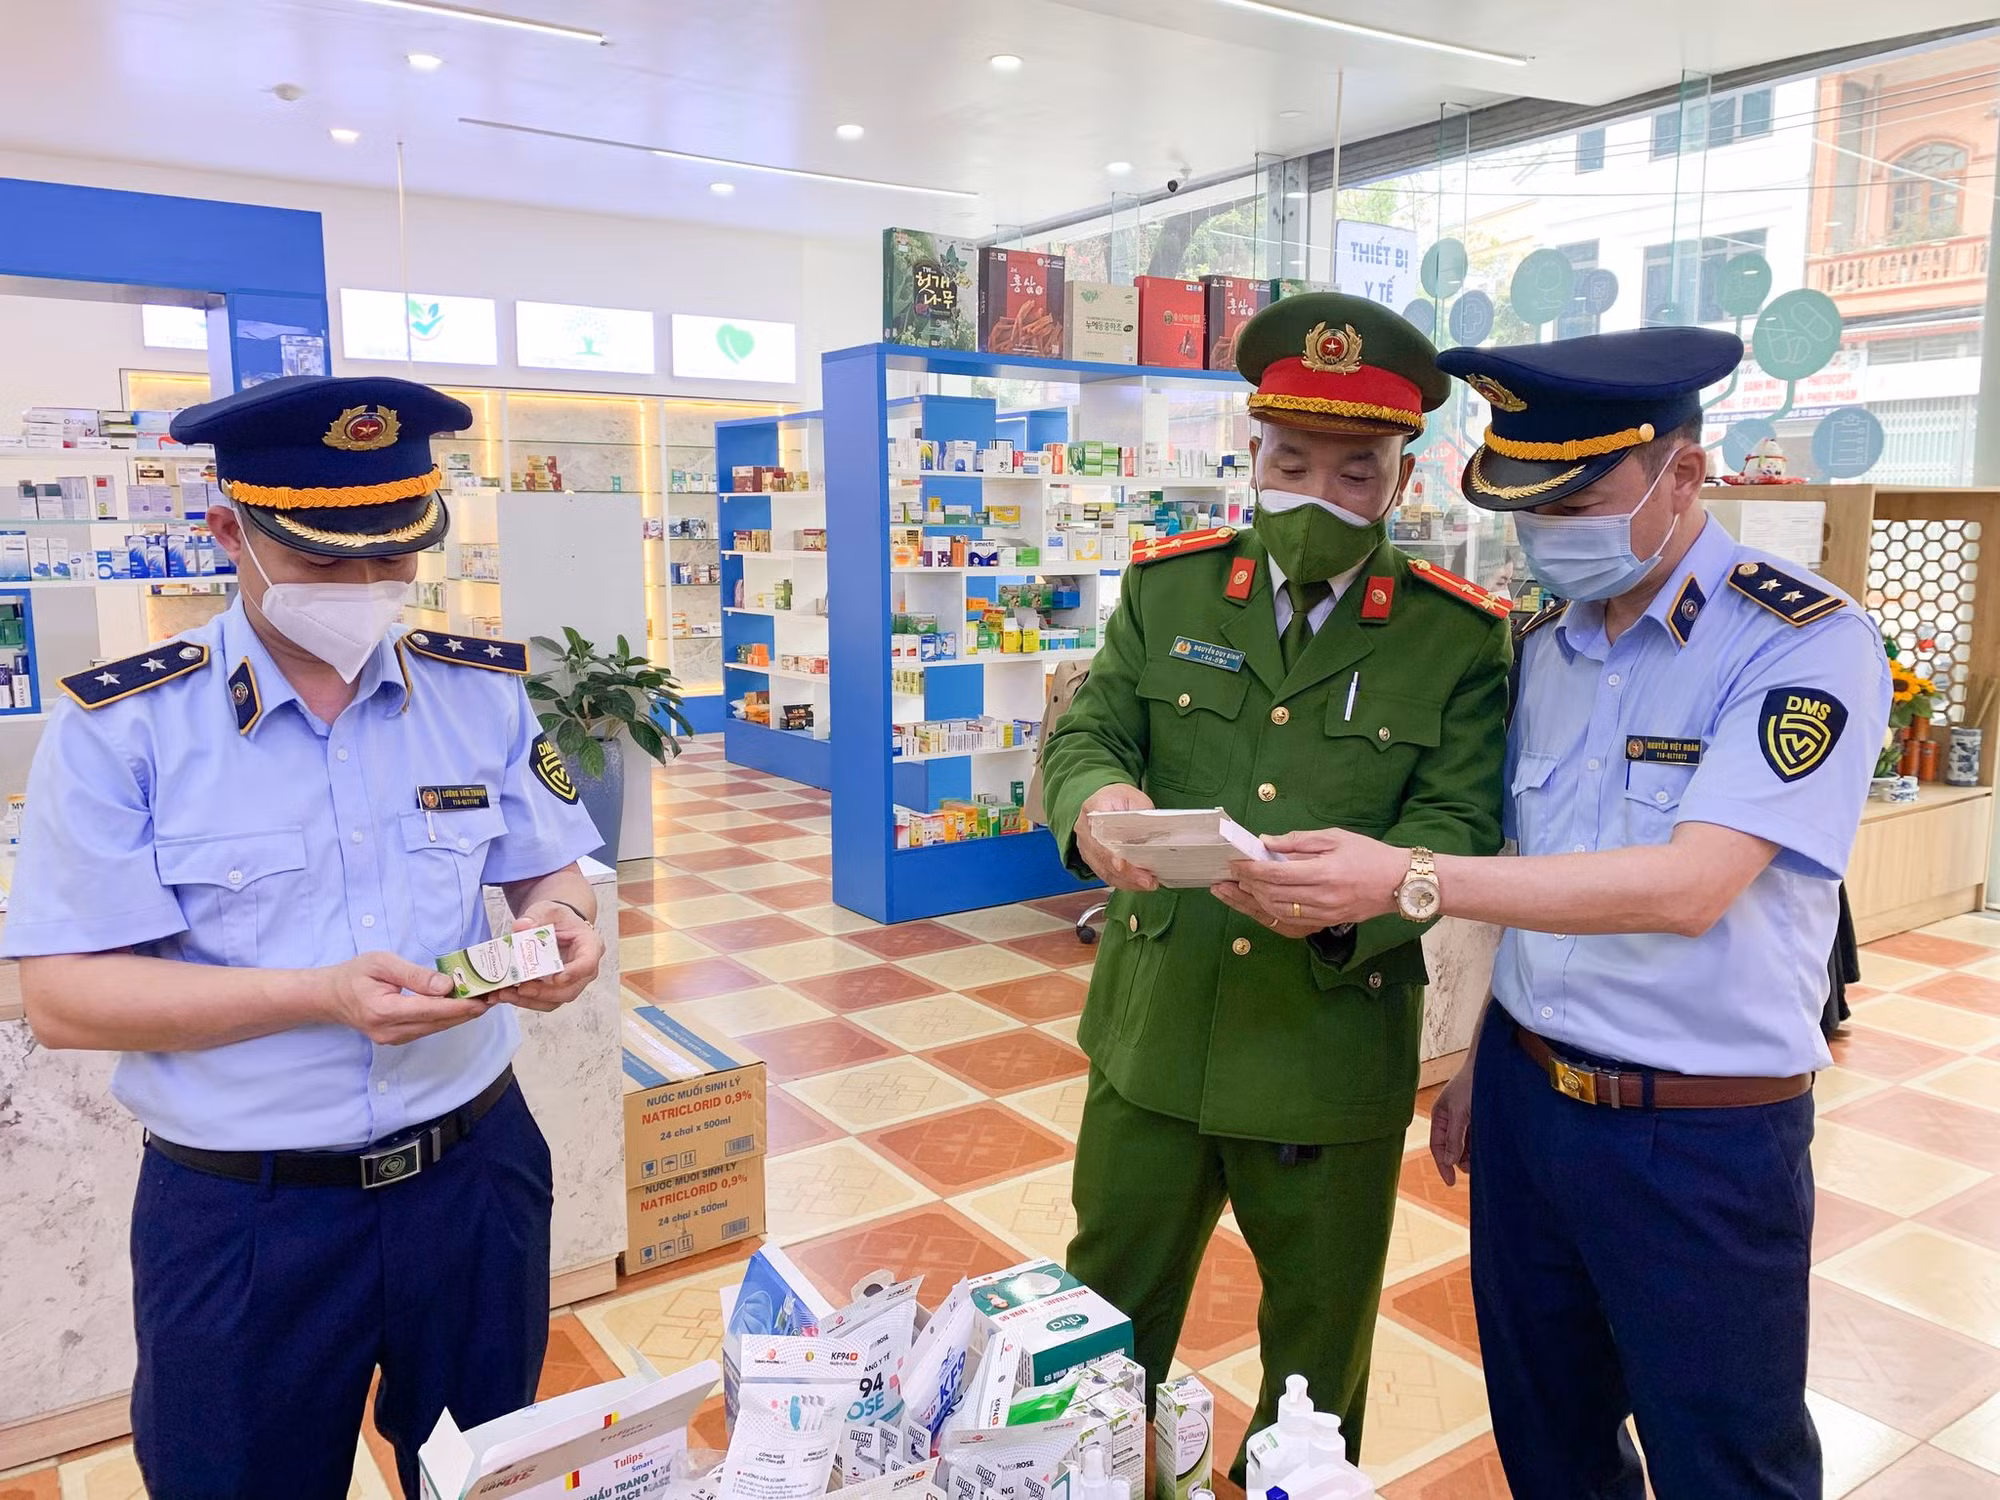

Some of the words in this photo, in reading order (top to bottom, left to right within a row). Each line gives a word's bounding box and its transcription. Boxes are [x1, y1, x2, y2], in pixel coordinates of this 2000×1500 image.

[1351, 236, 1390, 266] THIẾT
[1395, 248, 1409, 274] BỊ
[924, 290, 955, 309] 나무
[1365, 281, 1374, 298] Y
[1379, 275, 1396, 303] TẾ
[1786, 695, 1831, 721] DMS
[537, 741, 553, 756] DM
[647, 1092, 675, 1107] NƯỚC
[677, 1083, 703, 1099] MUỐI
[705, 1080, 728, 1094] SINH
[730, 1075, 742, 1088] LÝ
[642, 1096, 721, 1126] NATRICLORID
[724, 1089, 752, 1106] 0,9%
[660, 1131, 672, 1142] 24
[674, 1125, 694, 1138] chai
[696, 1124, 701, 1132] x
[704, 1115, 731, 1130] 500ml
[702, 1163, 724, 1179] SINH
[640, 1181, 718, 1213] NATRICLORID
[721, 1173, 748, 1190] 0,9%
[658, 1216, 669, 1227] 24
[672, 1210, 691, 1222] chai
[693, 1209, 698, 1217] x
[701, 1200, 728, 1215] 500ml
[1050, 1314, 1082, 1330] niva
[831, 1352, 850, 1361] KF94
[859, 1371, 884, 1398] 94
[847, 1391, 885, 1420] OSE
[613, 1451, 644, 1469] Tulips
[631, 1459, 654, 1473] Smart
[614, 1474, 650, 1494] TRANG
[652, 1468, 658, 1478] Y
